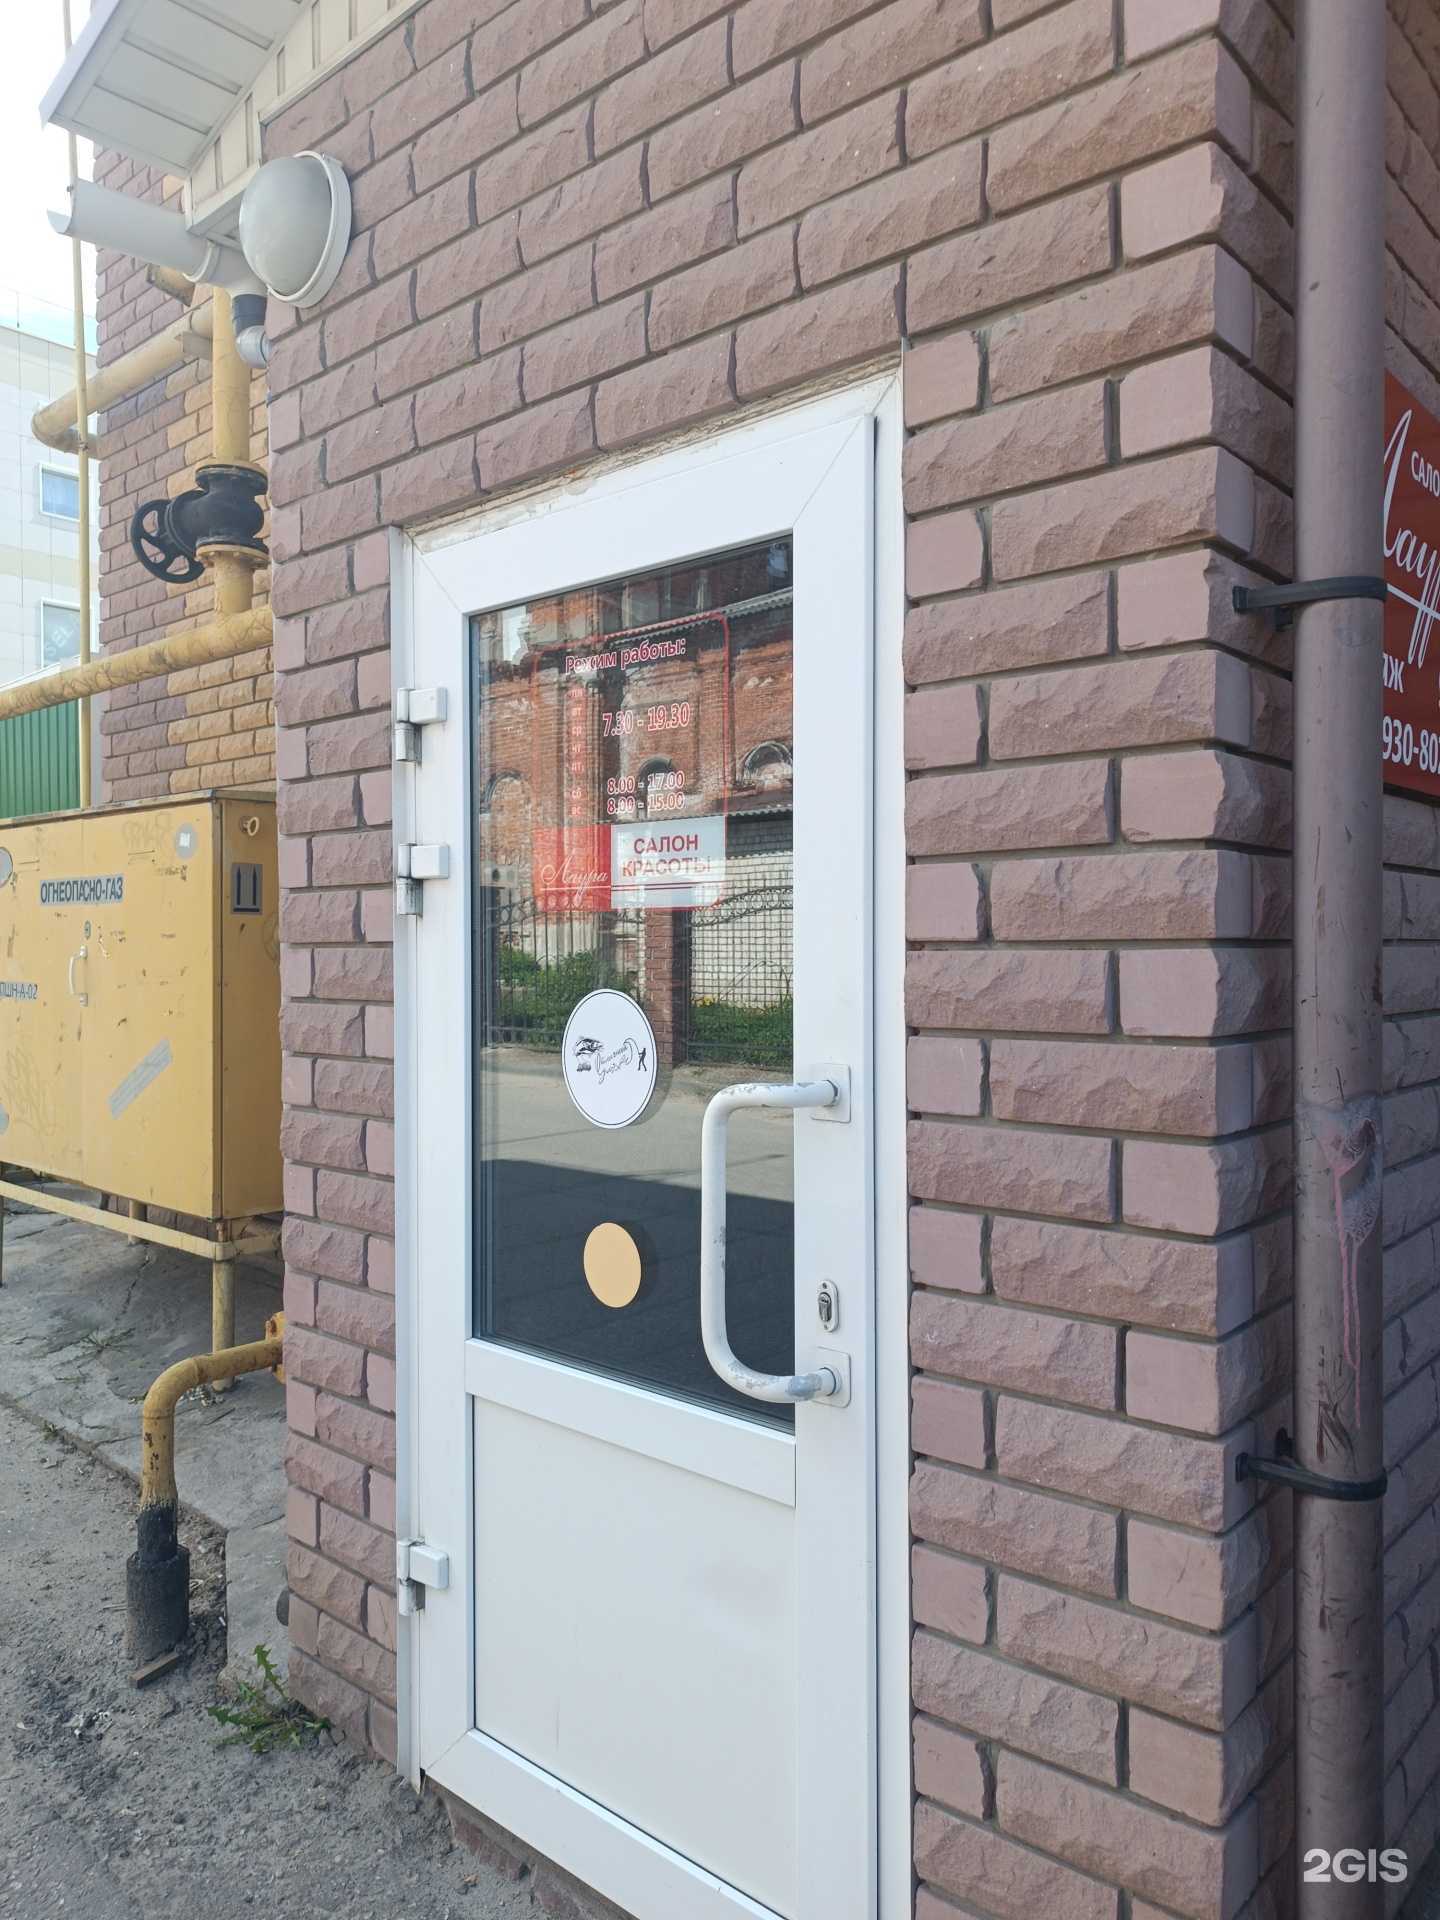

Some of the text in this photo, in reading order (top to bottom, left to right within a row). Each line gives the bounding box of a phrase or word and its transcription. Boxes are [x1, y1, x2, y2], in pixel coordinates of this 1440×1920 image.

[565, 638, 687, 675] Режим работы:
[602, 710, 634, 737] 7.30
[647, 702, 691, 732] 19.30
[606, 775, 636, 795] 8.00
[647, 770, 686, 791] 17.00
[606, 796, 636, 815] 8.00
[647, 791, 686, 812] 15.00
[633, 834, 699, 855] САЛОН
[622, 856, 712, 877] КРАСОТЫ
[40, 876, 124, 903] ОГНЕОПАСНО-ГАЗ
